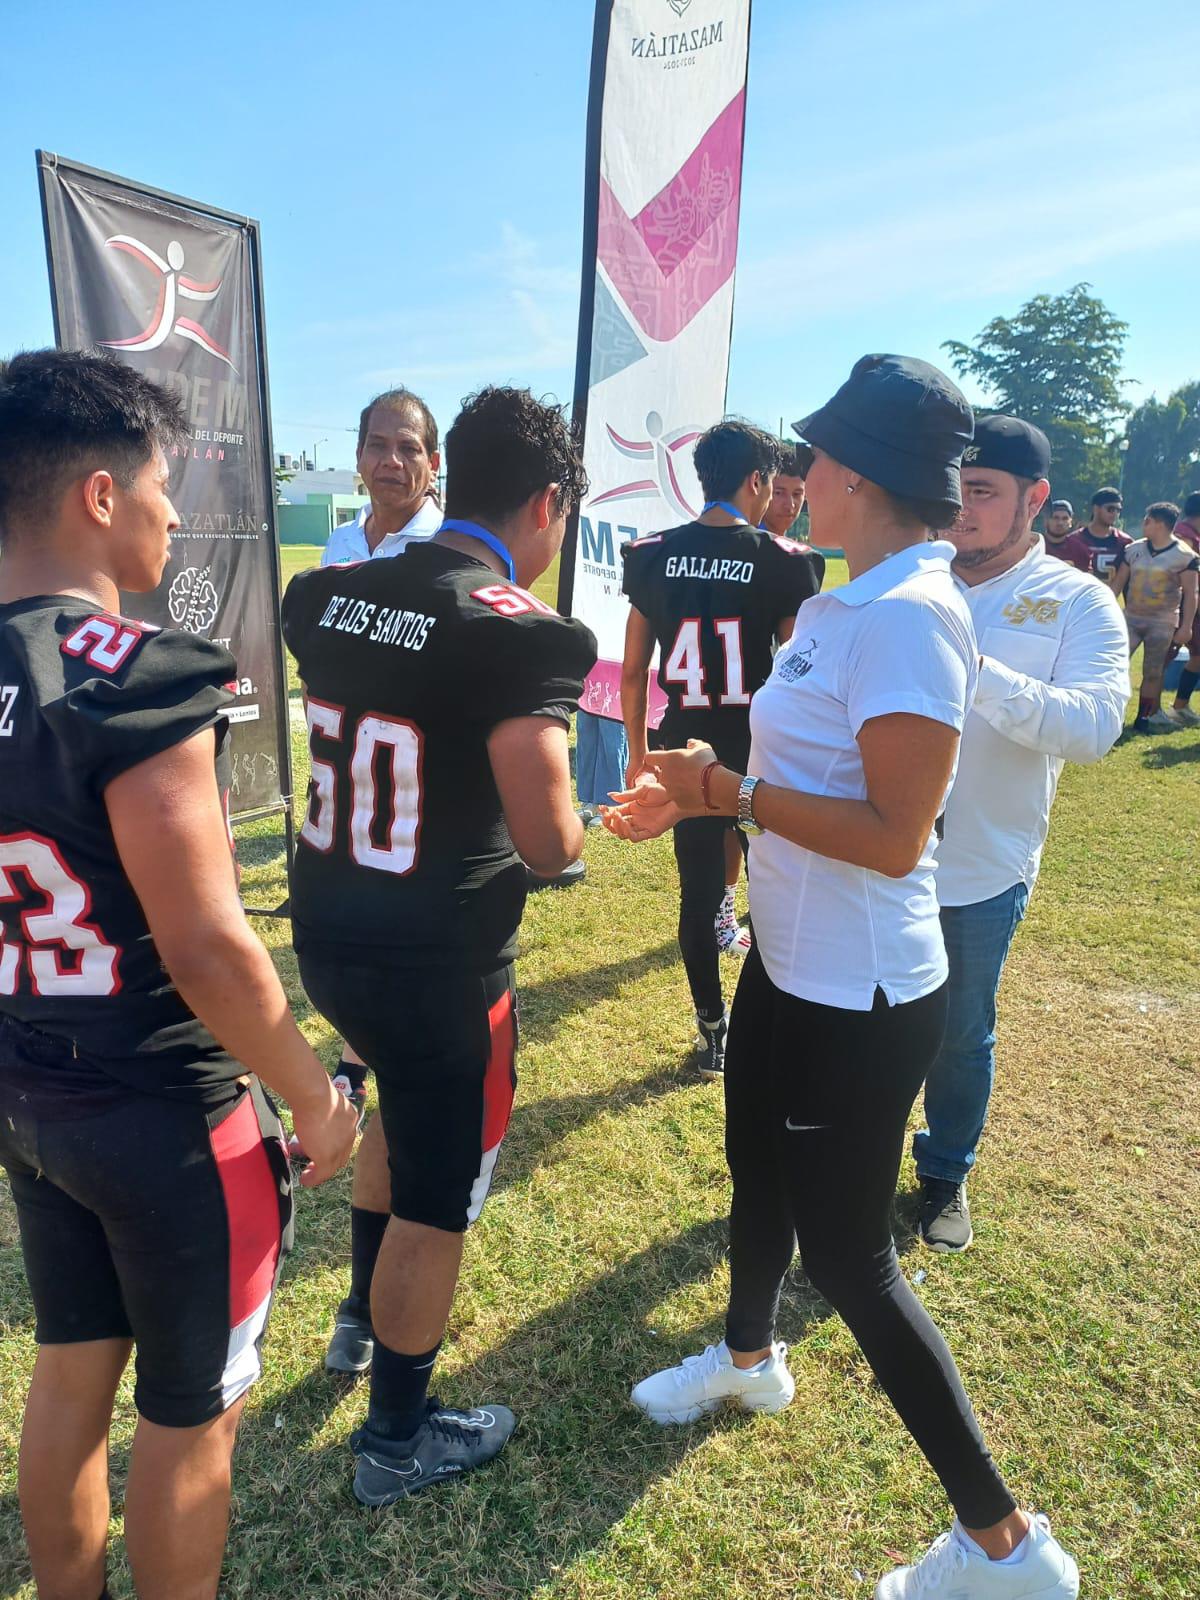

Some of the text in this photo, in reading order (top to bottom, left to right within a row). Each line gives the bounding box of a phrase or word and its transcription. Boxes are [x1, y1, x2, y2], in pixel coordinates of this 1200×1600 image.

[195, 429, 212, 441] DEL
[213, 431, 244, 445] DEPORTE
[665, 556, 754, 584] GALLARZO
[319, 595, 437, 651] DE LOS SANTOS
[665, 617, 754, 710] 41
